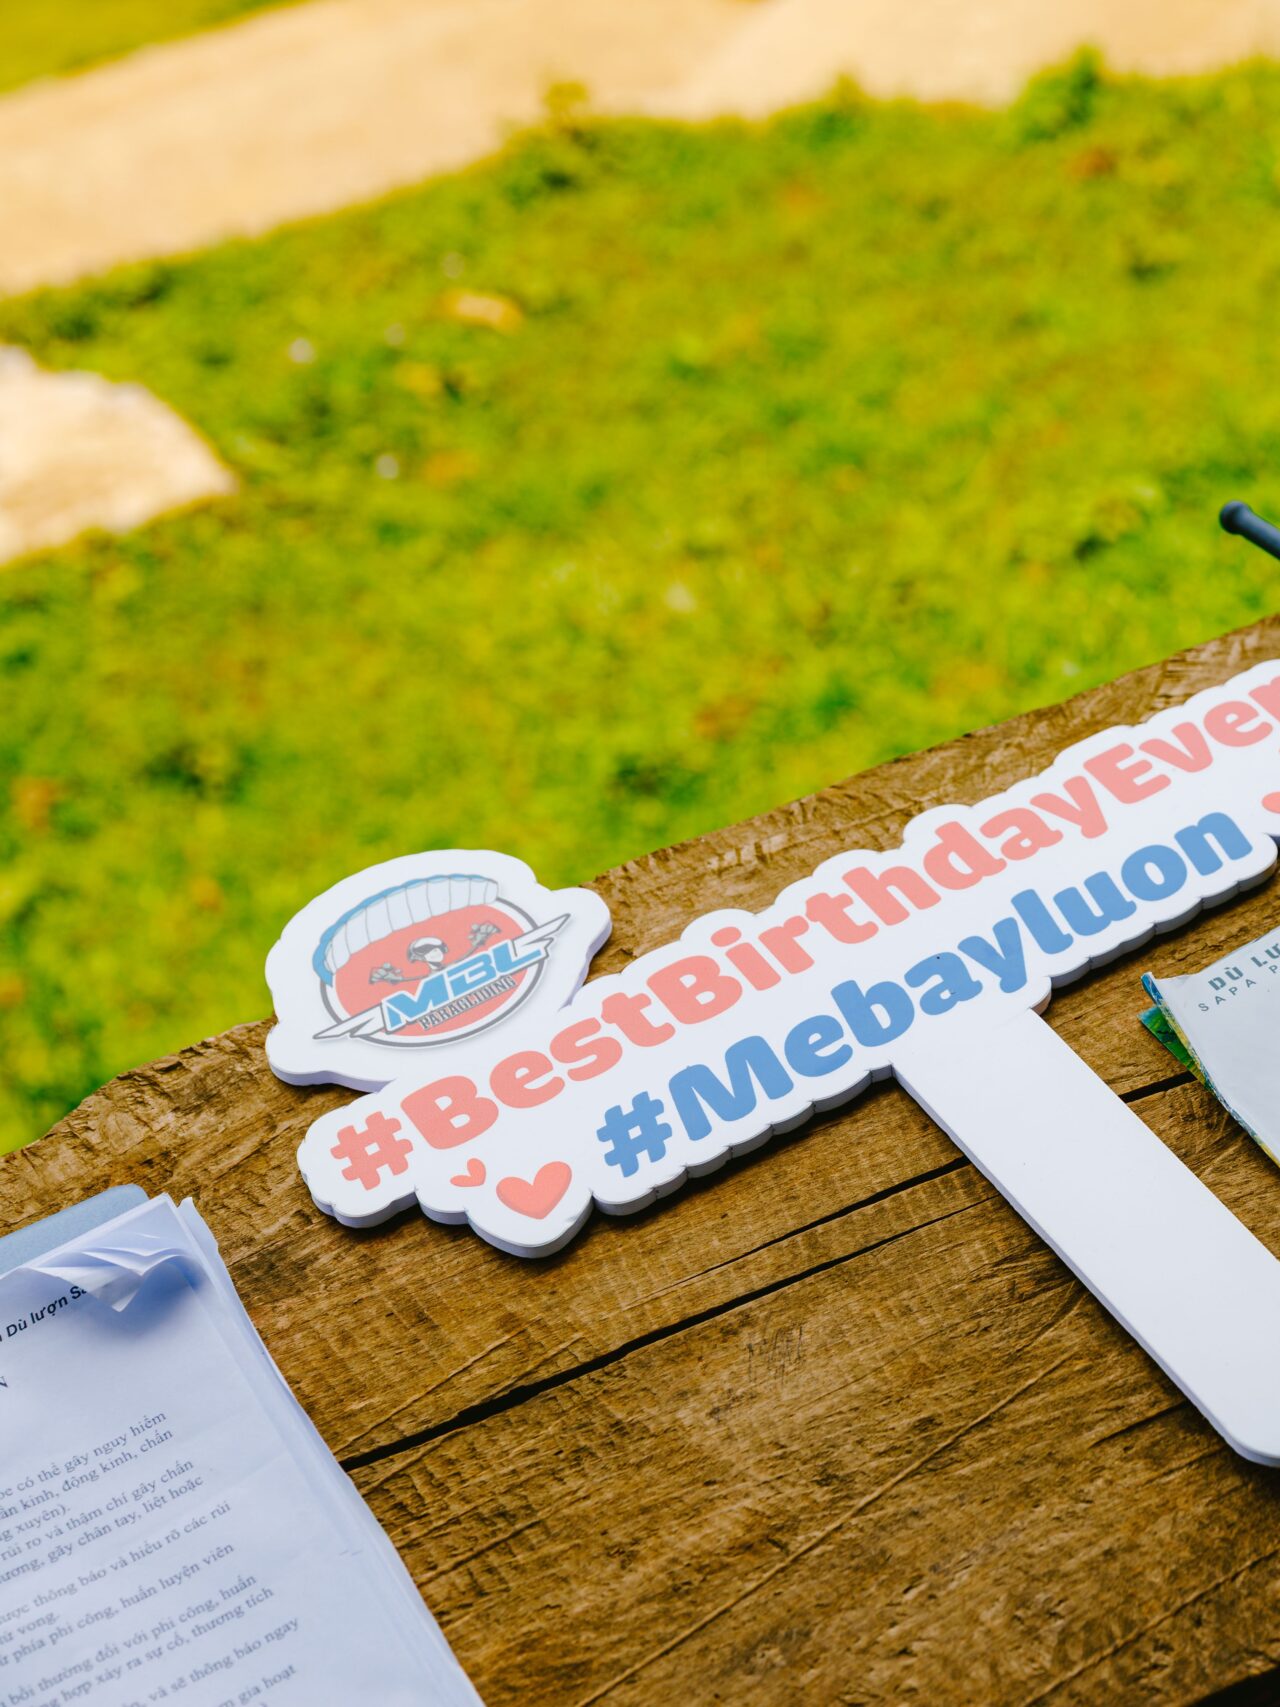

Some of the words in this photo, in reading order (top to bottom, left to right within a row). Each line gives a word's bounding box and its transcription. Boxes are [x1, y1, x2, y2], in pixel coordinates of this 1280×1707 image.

[386, 942, 542, 1028] MBL
[419, 975, 516, 1030] PARAGLIDING
[596, 811, 1253, 1178] #Mebayluon
[1198, 978, 1256, 1012] SAPA
[1208, 965, 1244, 991] DÙ
[6, 1318, 28, 1338] Dù
[30, 1296, 68, 1324] lượn
[17, 1476, 34, 1491] có
[64, 1452, 89, 1473] gây
[93, 1433, 127, 1456] nguy
[129, 1412, 167, 1437] hiểm
[62, 1469, 100, 1492] động
[99, 1451, 138, 1473] kinh,
[139, 1429, 173, 1453] chấn
[0, 1558, 45, 1585] ương,
[78, 1524, 112, 1546] chân
[142, 1495, 168, 1514] liệt
[168, 1476, 204, 1500] hoặc
[16, 1504, 71, 1533] xuyên).
[26, 1537, 42, 1550] ro
[45, 1525, 64, 1540] và
[66, 1508, 103, 1531] thậm
[105, 1491, 128, 1512] chí
[131, 1479, 156, 1501] gây
[160, 1460, 194, 1483] chấn
[33, 1582, 78, 1608] thông
[78, 1568, 107, 1587] báo
[110, 1556, 128, 1571] và
[183, 1513, 208, 1534] các
[210, 1500, 232, 1521] rủi
[12, 1639, 46, 1663] phía
[49, 1622, 74, 1646] phi
[119, 1585, 158, 1609] huấn
[158, 1563, 201, 1590] luyện
[202, 1544, 235, 1566] viên
[123, 1630, 148, 1649] với
[151, 1619, 176, 1640] phi
[219, 1575, 257, 1601] huấn
[126, 1657, 142, 1671] ra
[191, 1605, 245, 1638] thương
[245, 1587, 275, 1608] tích
[148, 1687, 168, 1702] và
[189, 1656, 234, 1683] thông
[233, 1639, 262, 1660] báo
[264, 1618, 299, 1644] ngay
[238, 1686, 262, 1705] gia
[262, 1665, 297, 1690] hoạt
